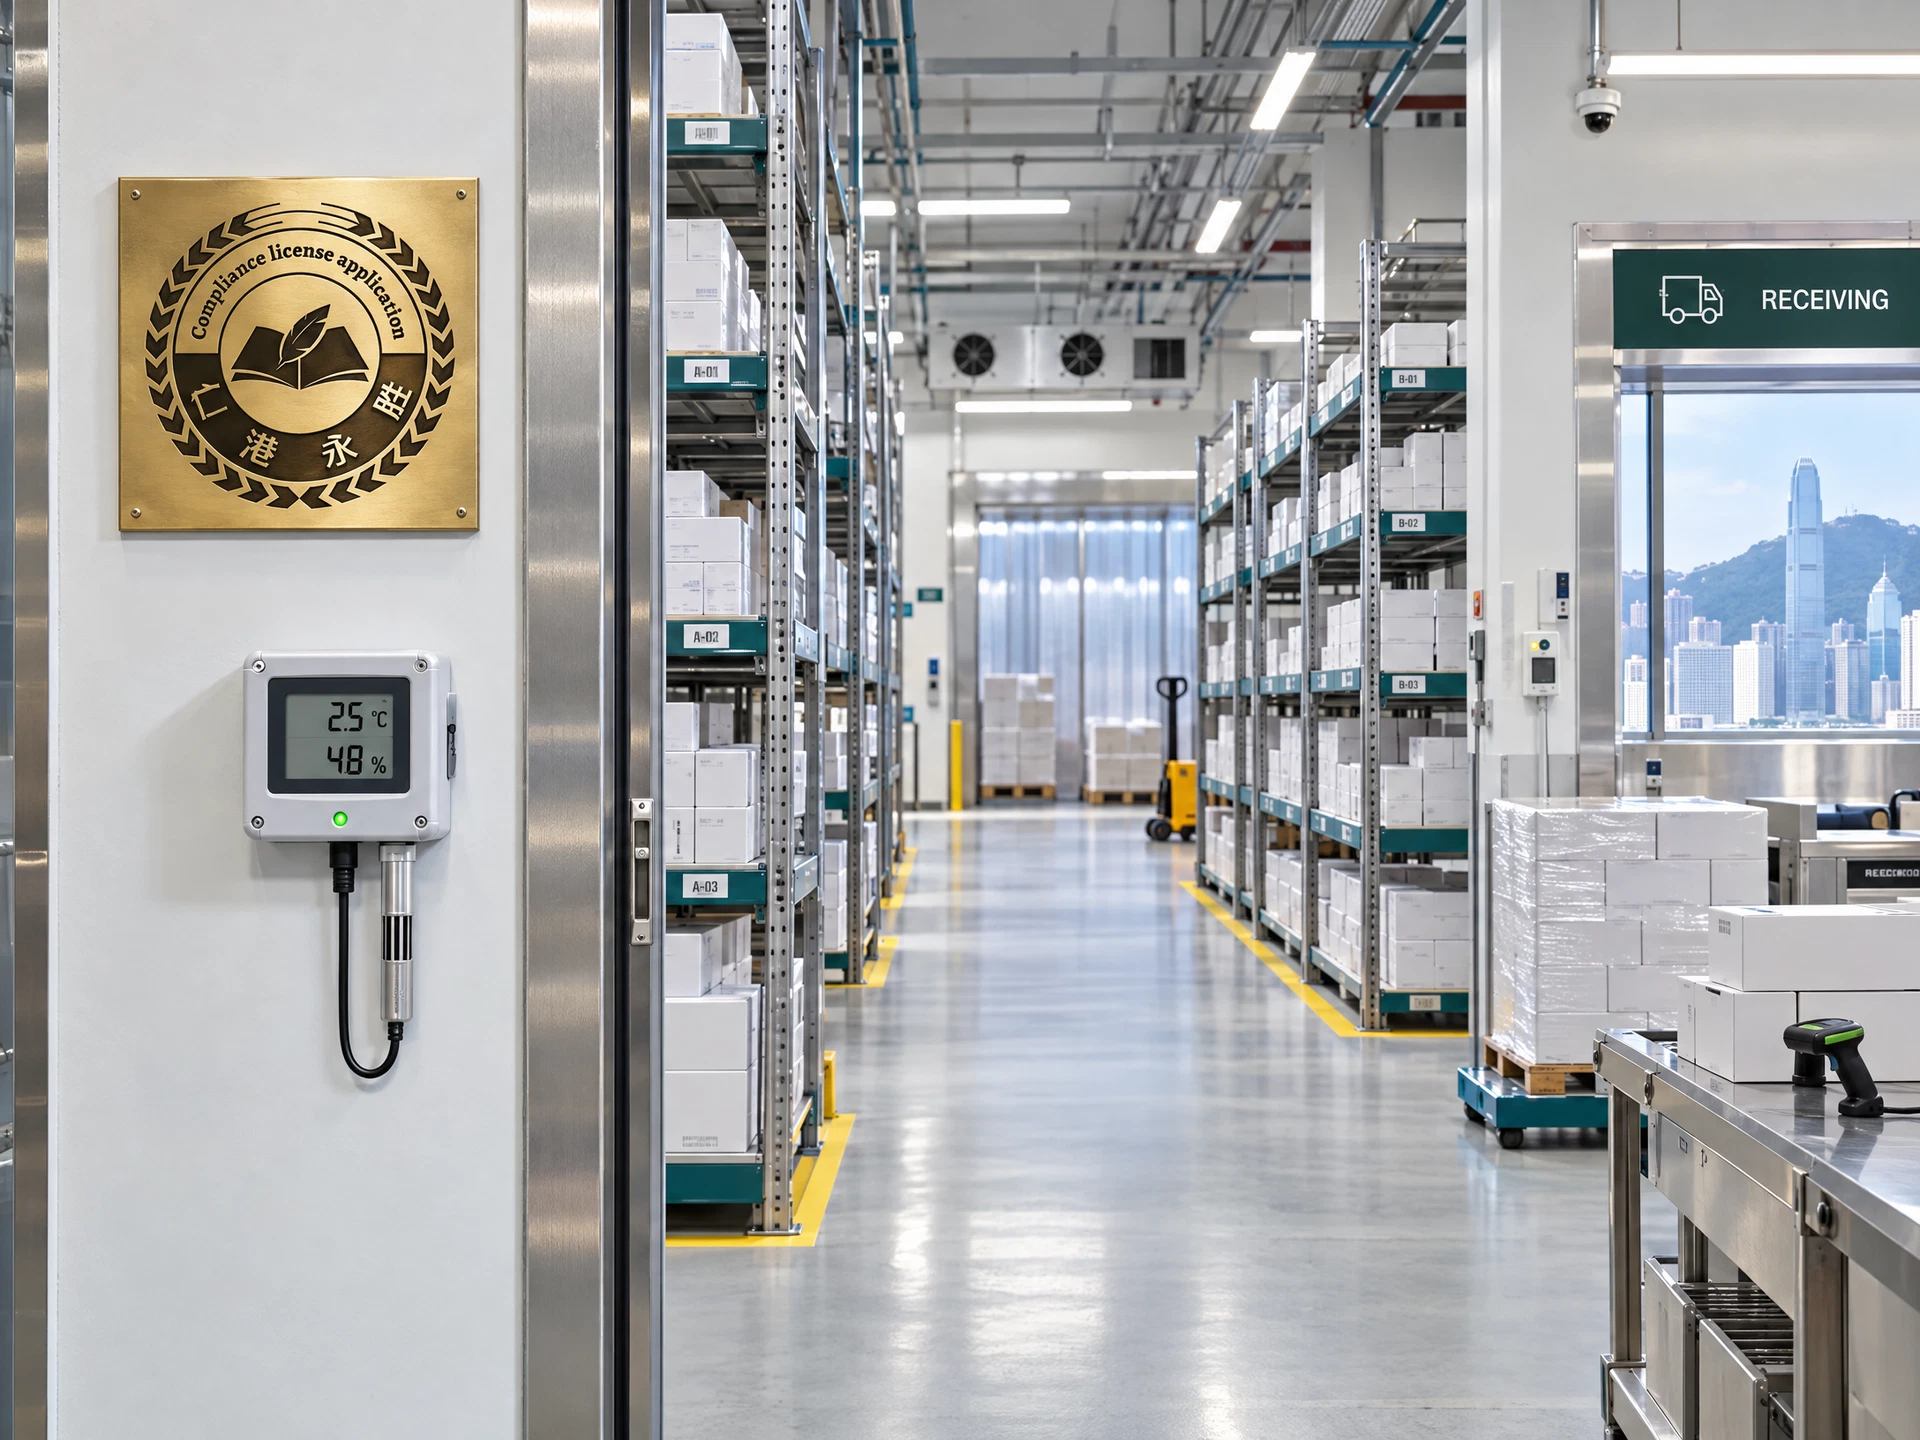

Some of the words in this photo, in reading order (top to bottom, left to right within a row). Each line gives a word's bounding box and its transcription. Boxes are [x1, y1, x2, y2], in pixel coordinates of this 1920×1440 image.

[191, 253, 267, 341] Compliance
[267, 243, 334, 262] license
[336, 253, 405, 341] application
[1762, 289, 1889, 310] RECEIVING
[1398, 374, 1418, 384] B-01
[1398, 518, 1419, 528] B-02
[693, 630, 719, 643] A-02
[1398, 680, 1419, 690] B-03
[328, 701, 363, 732] 2.5
[327, 744, 363, 775] 48
[371, 755, 387, 774] %
[692, 880, 718, 893] A-03
